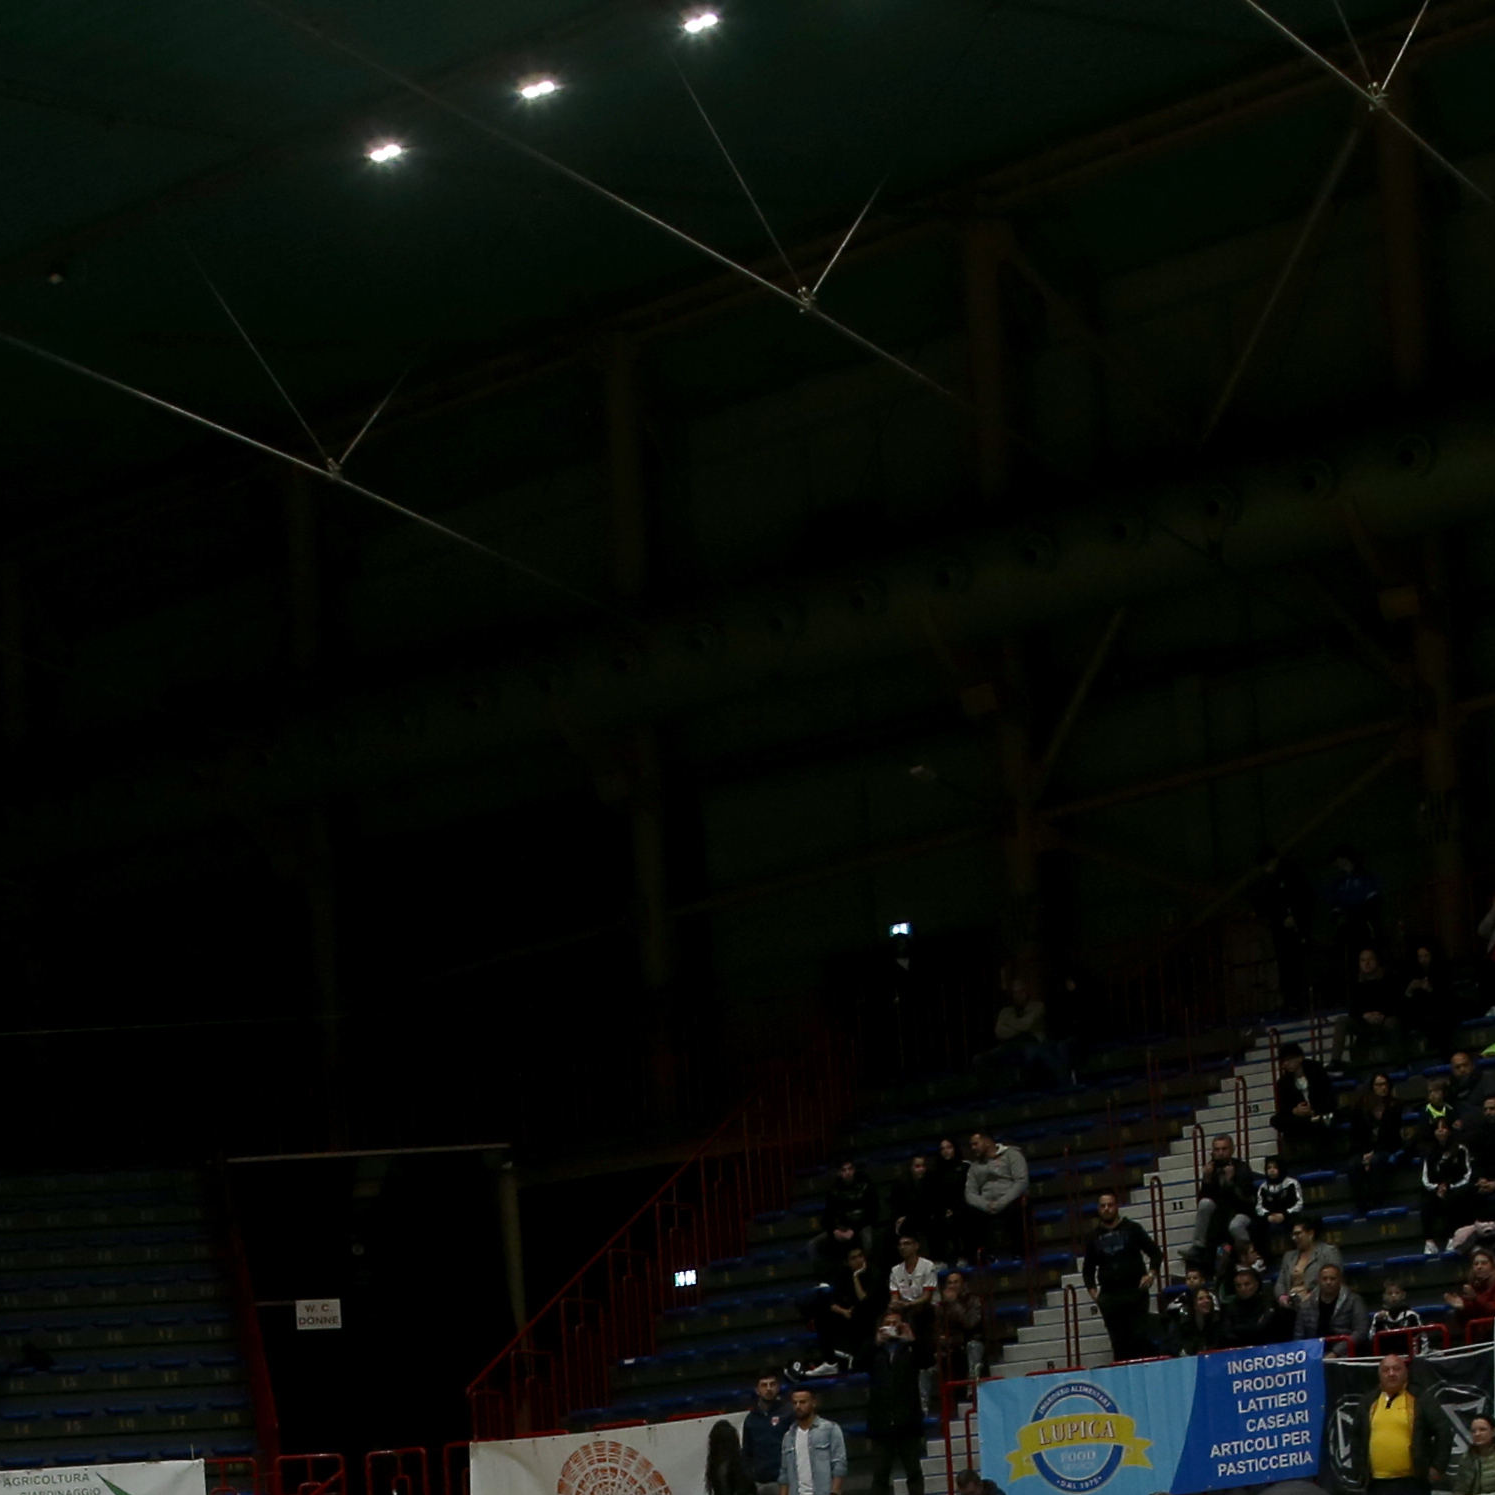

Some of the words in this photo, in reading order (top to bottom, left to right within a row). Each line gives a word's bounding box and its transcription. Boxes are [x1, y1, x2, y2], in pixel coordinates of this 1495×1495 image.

[1173, 1202, 1184, 1211] 11
[1227, 1350, 1306, 1375] INGROSSO
[1233, 1370, 1306, 1394] PRODOTTI
[1238, 1390, 1307, 1414] LATTIERO
[1039, 1420, 1116, 1446] LUPICA
[1246, 1411, 1310, 1433] CASEARI
[1210, 1434, 1279, 1458] ARTICOLI
[1282, 1430, 1311, 1448] PER
[1218, 1451, 1313, 1477] PASTICCERIA
[3, 1472, 91, 1488] AGRICOLTURA
